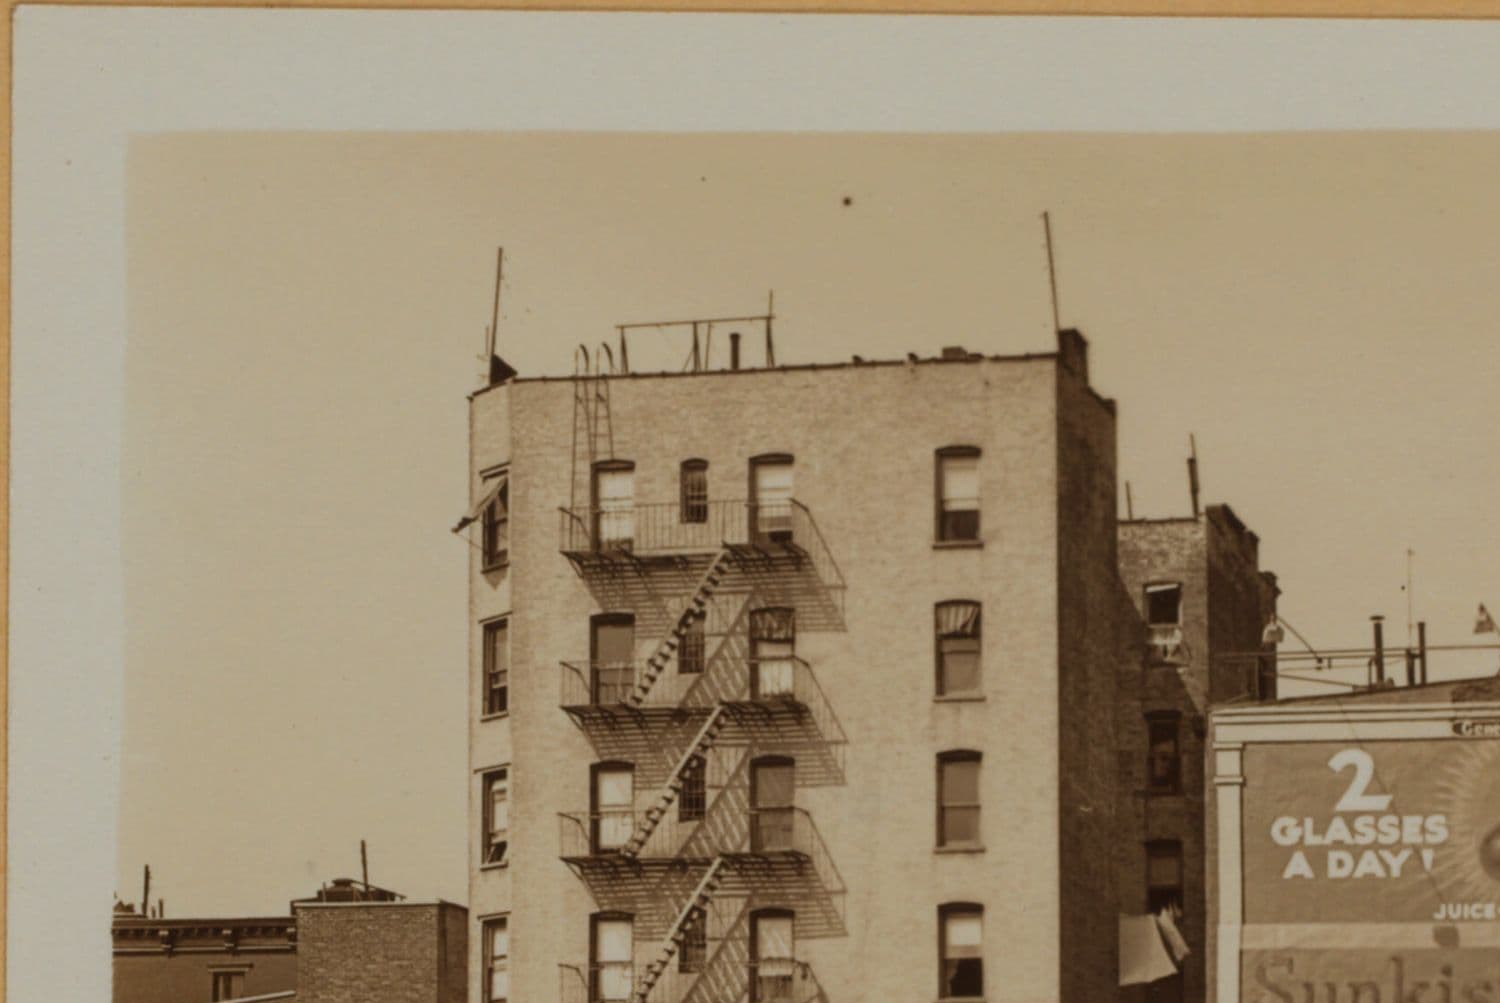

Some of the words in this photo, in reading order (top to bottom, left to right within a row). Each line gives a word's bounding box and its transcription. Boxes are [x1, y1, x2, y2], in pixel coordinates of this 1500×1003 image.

[1327, 747, 1394, 812] 2
[1270, 814, 1450, 847] GLASSES
[1282, 851, 1315, 880] A
